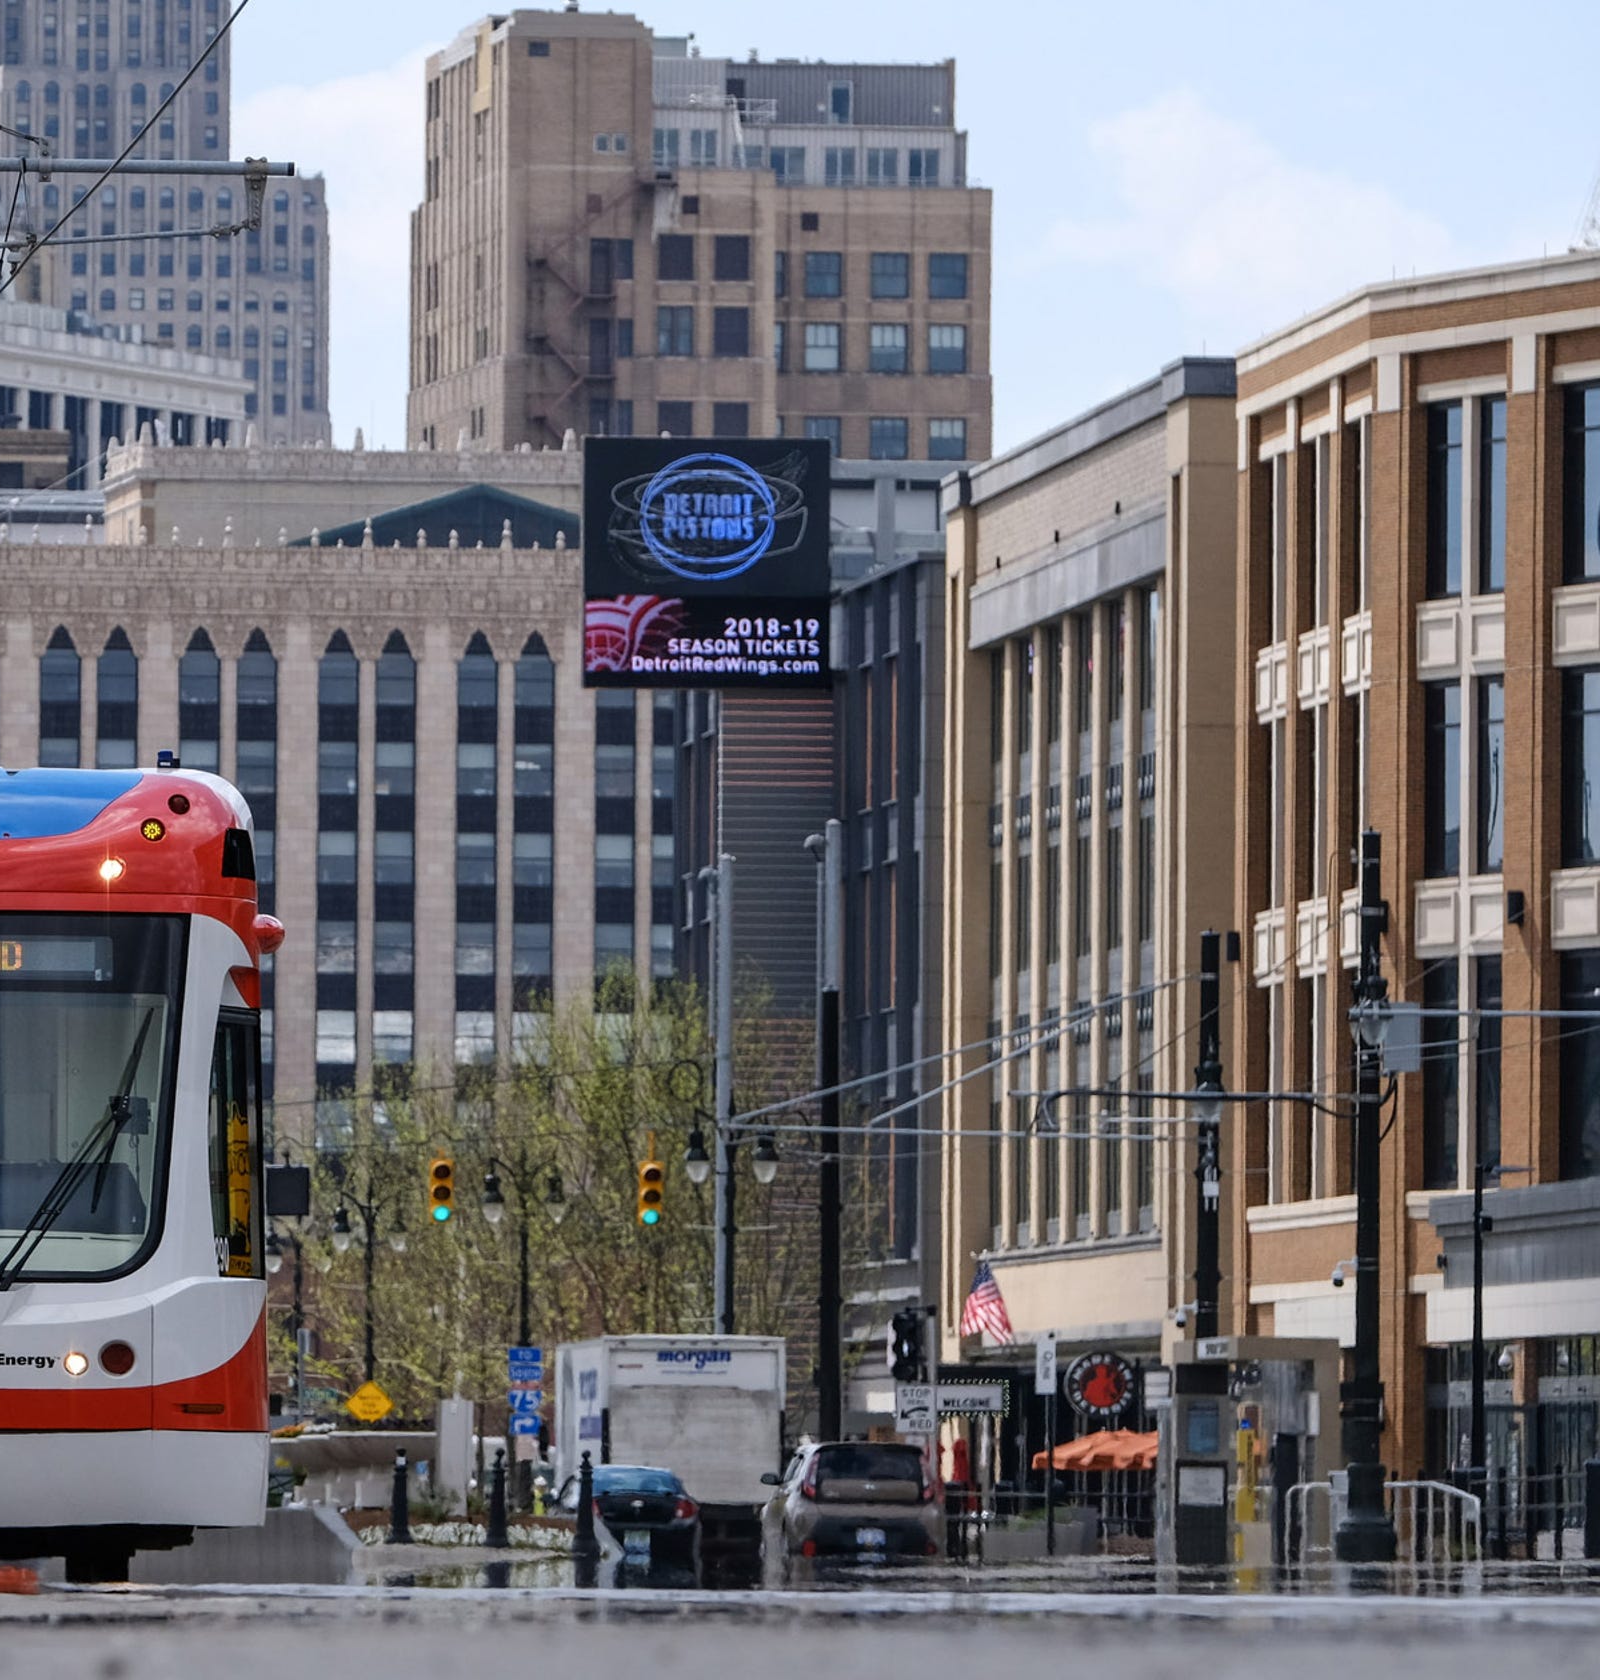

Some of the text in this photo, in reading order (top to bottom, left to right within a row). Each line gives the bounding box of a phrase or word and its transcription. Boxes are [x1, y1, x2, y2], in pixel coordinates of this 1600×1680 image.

[663, 493, 755, 516] DETROIT
[663, 517, 755, 540] PISTONS
[724, 617, 820, 638] 2018-19
[667, 638, 820, 656] SEASON TICKETS
[631, 656, 820, 676] DetroitRedWings.com
[656, 1350, 731, 1369] morgan
[511, 1390, 539, 1410] 75
[902, 1388, 931, 1398] STOP
[943, 1398, 990, 1408] WELCOME
[909, 1420, 932, 1429] RED
